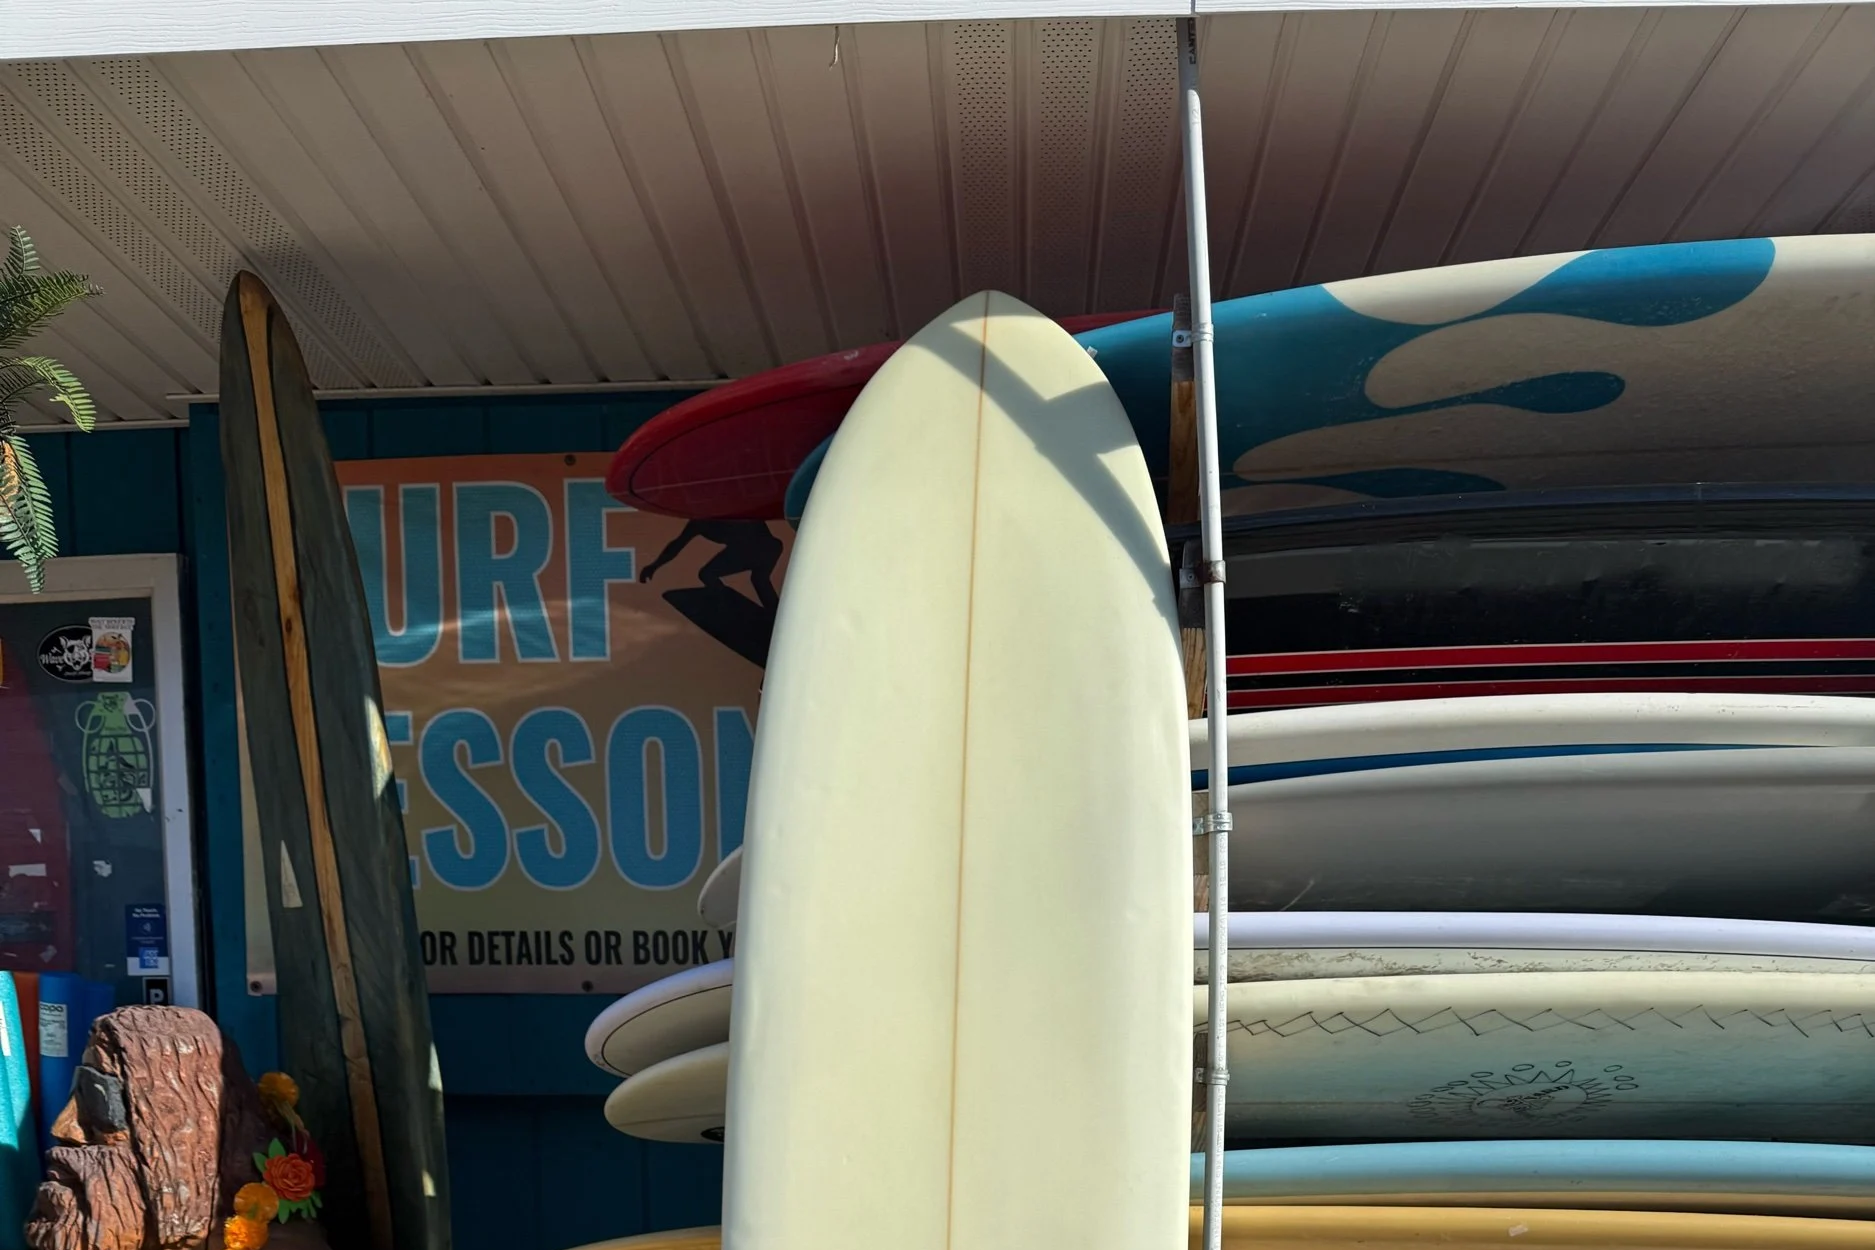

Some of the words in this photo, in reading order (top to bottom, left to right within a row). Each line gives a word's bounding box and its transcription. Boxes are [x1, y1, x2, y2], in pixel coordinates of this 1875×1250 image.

[343, 478, 637, 668] URF
[421, 931, 458, 966] OR
[467, 931, 575, 966] DETAILS
[584, 930, 623, 966] OR
[633, 930, 709, 966] BOOK
